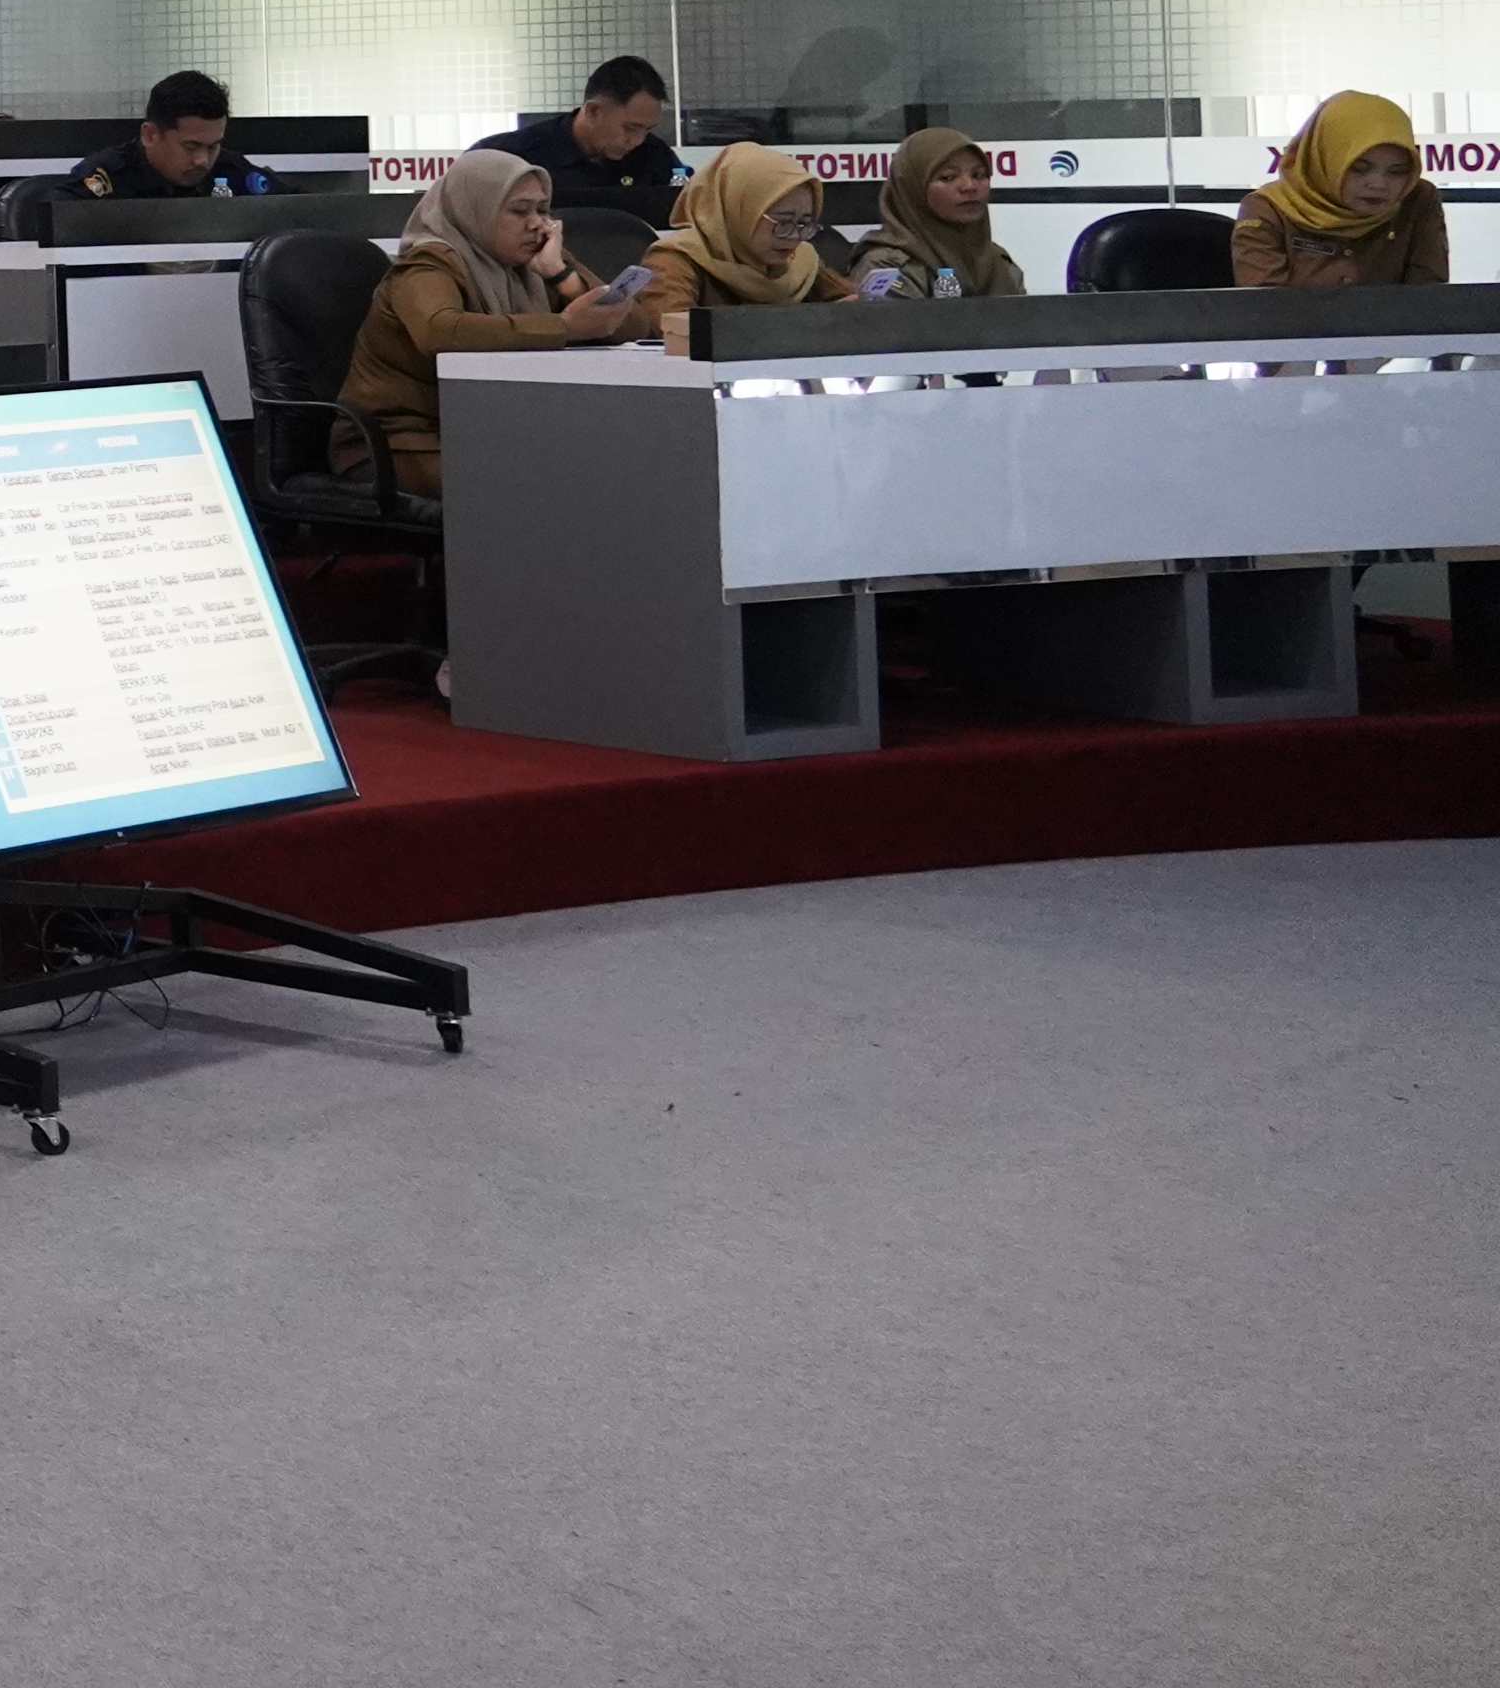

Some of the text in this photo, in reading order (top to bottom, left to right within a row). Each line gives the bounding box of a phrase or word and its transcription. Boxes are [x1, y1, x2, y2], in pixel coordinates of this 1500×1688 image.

[97, 435, 138, 447] PROGRAM
[137, 527, 153, 537] SAE
[119, 675, 168, 689] BERKAT SAE
[125, 691, 172, 706] Car Free Day
[189, 720, 206, 731] SAE
[40, 743, 64, 755] PUPR
